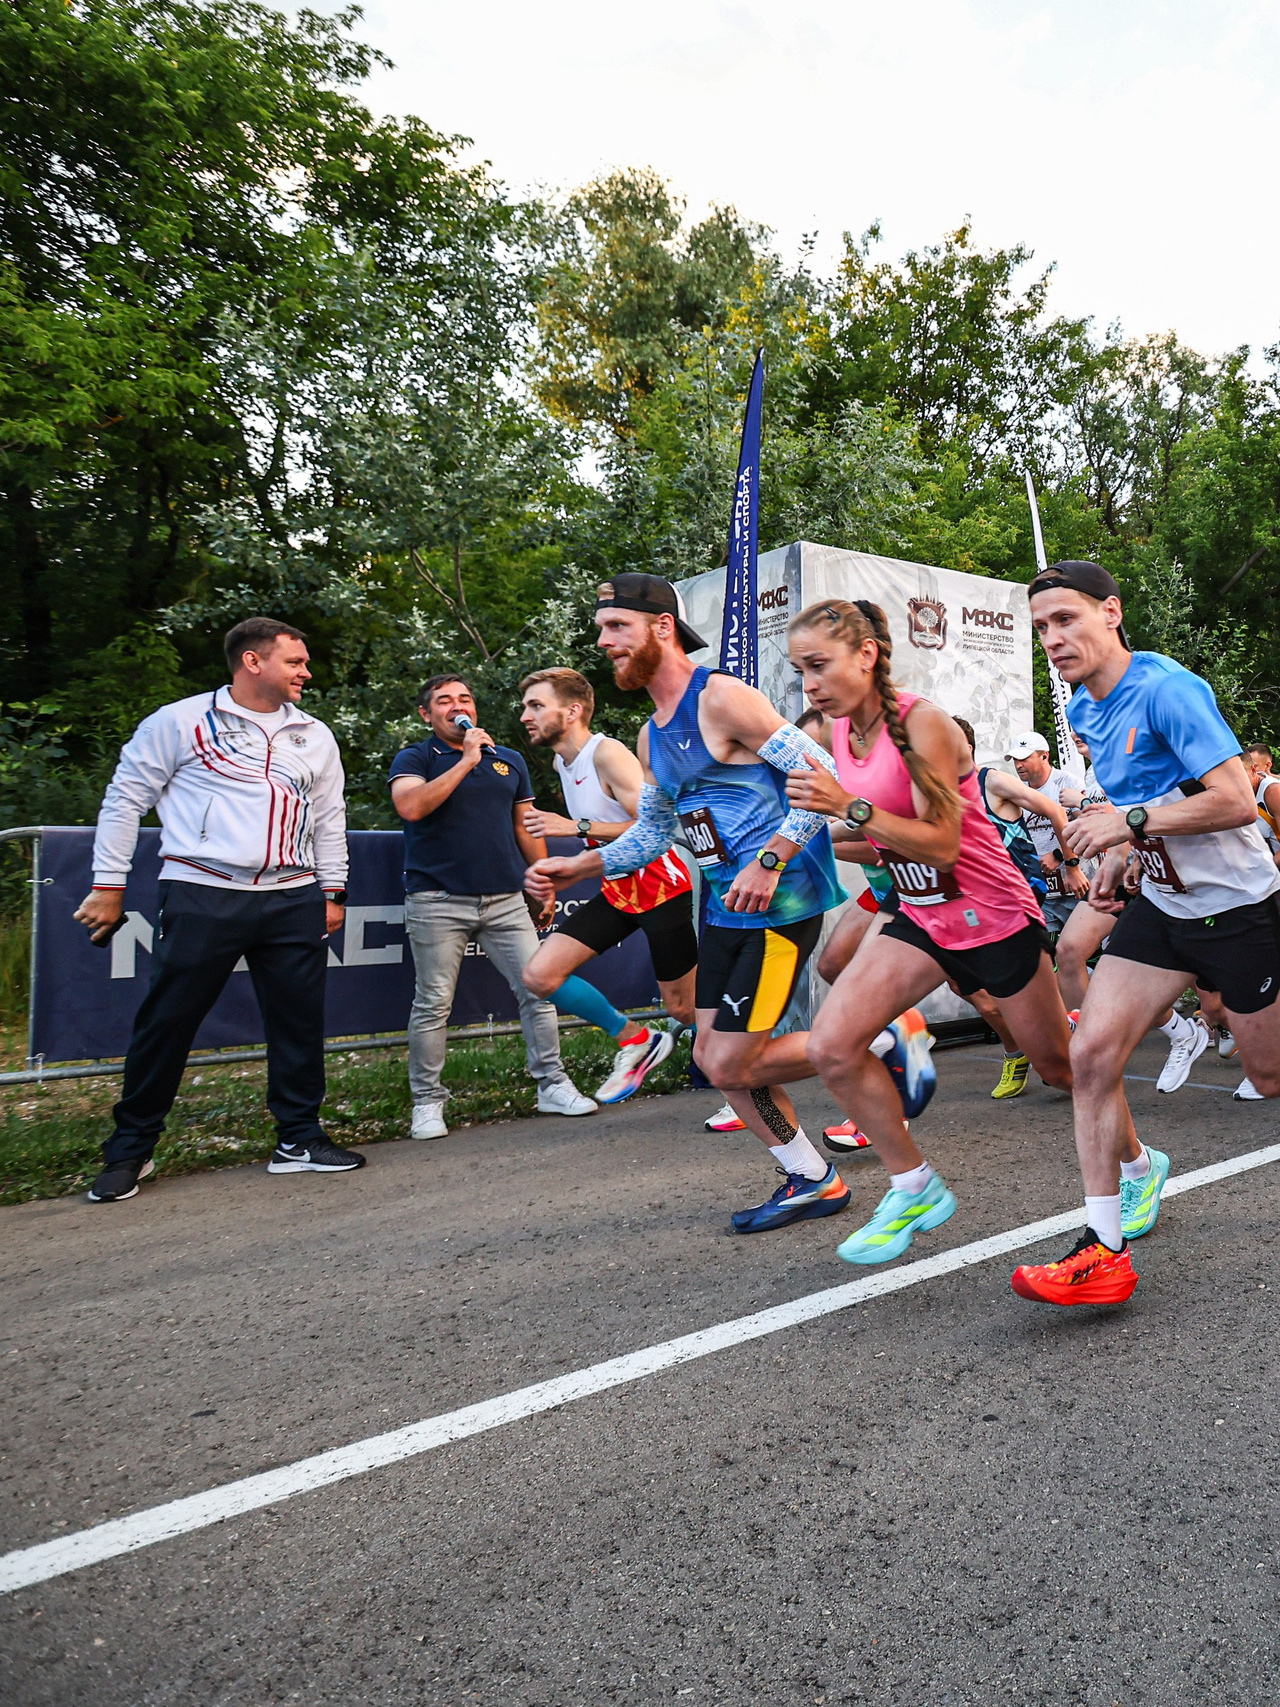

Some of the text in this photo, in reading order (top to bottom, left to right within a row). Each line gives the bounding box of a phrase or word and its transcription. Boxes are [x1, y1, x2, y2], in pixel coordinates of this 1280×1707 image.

[742, 466, 750, 527] СПОРТА
[741, 545, 750, 623] КУЛЬТУРЫ
[962, 606, 1014, 631] МФКС
[962, 630, 1015, 643] МИНИСТЕРСТВО
[962, 644, 1015, 655] ЛИПЕЦКОЙ ОБЛАСТИ
[888, 862, 938, 891] 1109
